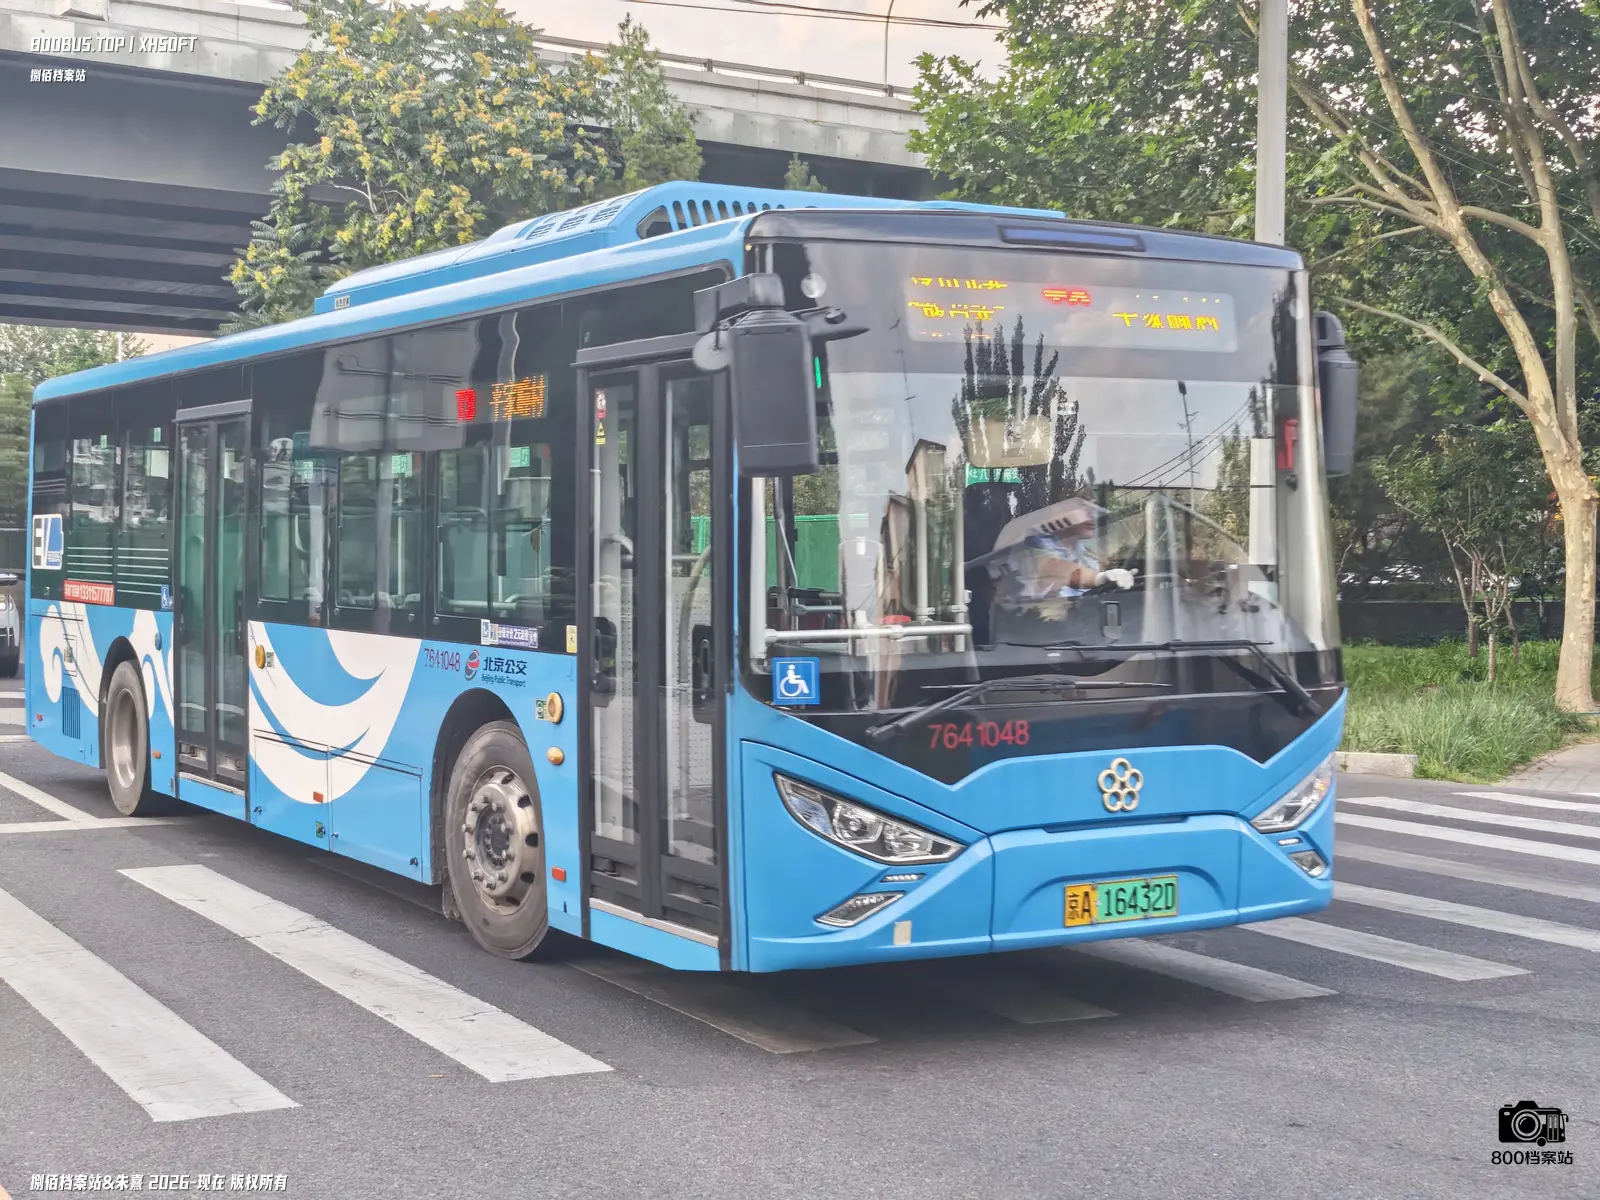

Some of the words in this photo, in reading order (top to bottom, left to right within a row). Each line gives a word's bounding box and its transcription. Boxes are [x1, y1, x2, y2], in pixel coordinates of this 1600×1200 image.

[424, 648, 461, 672] 7641048
[483, 656, 528, 676] 北京公交
[928, 719, 1030, 749] 7641048
[1103, 881, 1176, 917] 16432D
